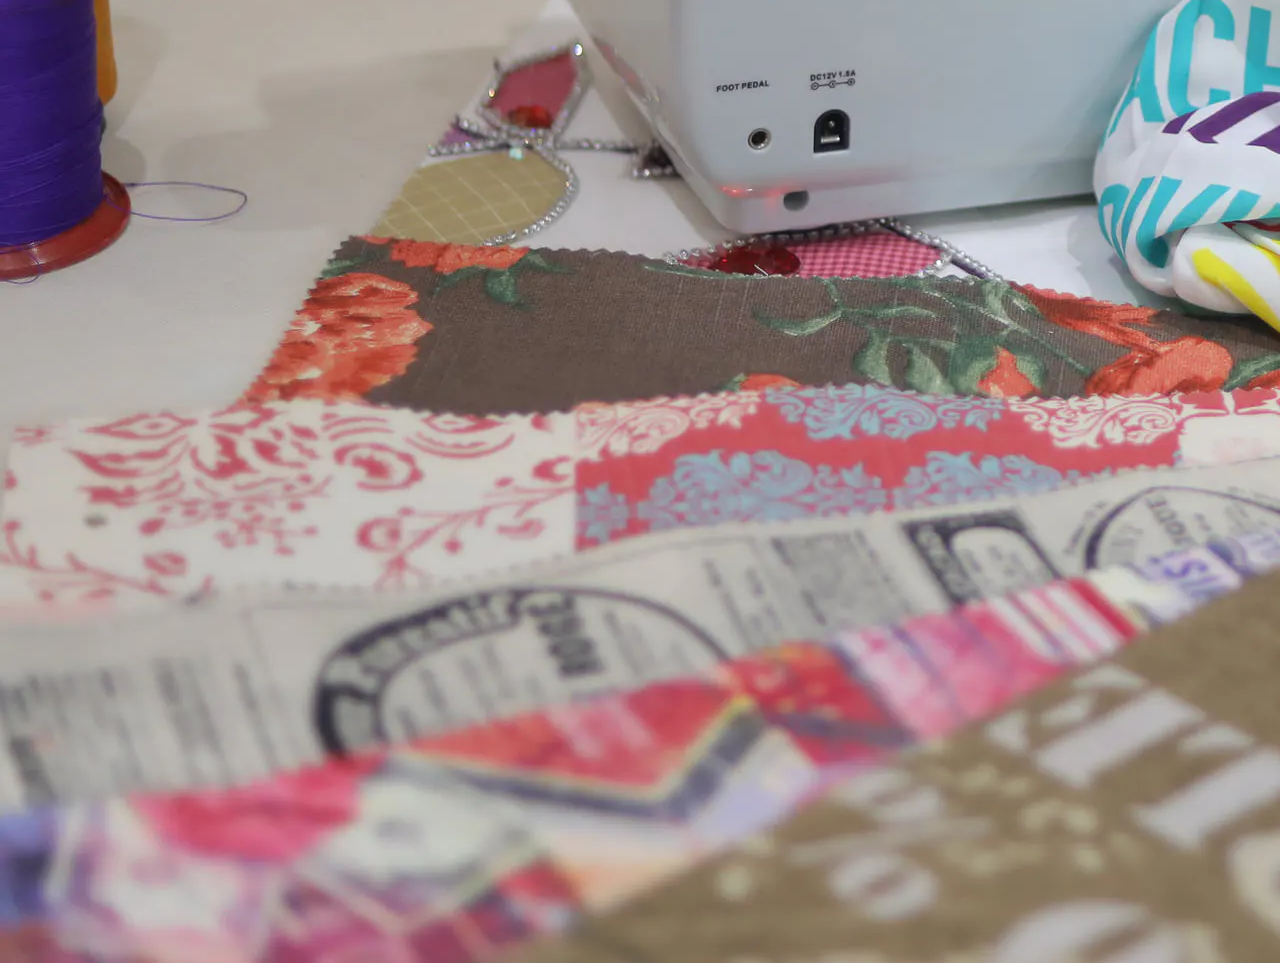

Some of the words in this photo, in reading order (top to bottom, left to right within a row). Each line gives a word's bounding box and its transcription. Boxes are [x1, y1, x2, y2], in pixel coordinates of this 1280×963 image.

[809, 72, 837, 82] DC12V
[715, 83, 740, 93] FOOT
[741, 80, 770, 90] PEDAL
